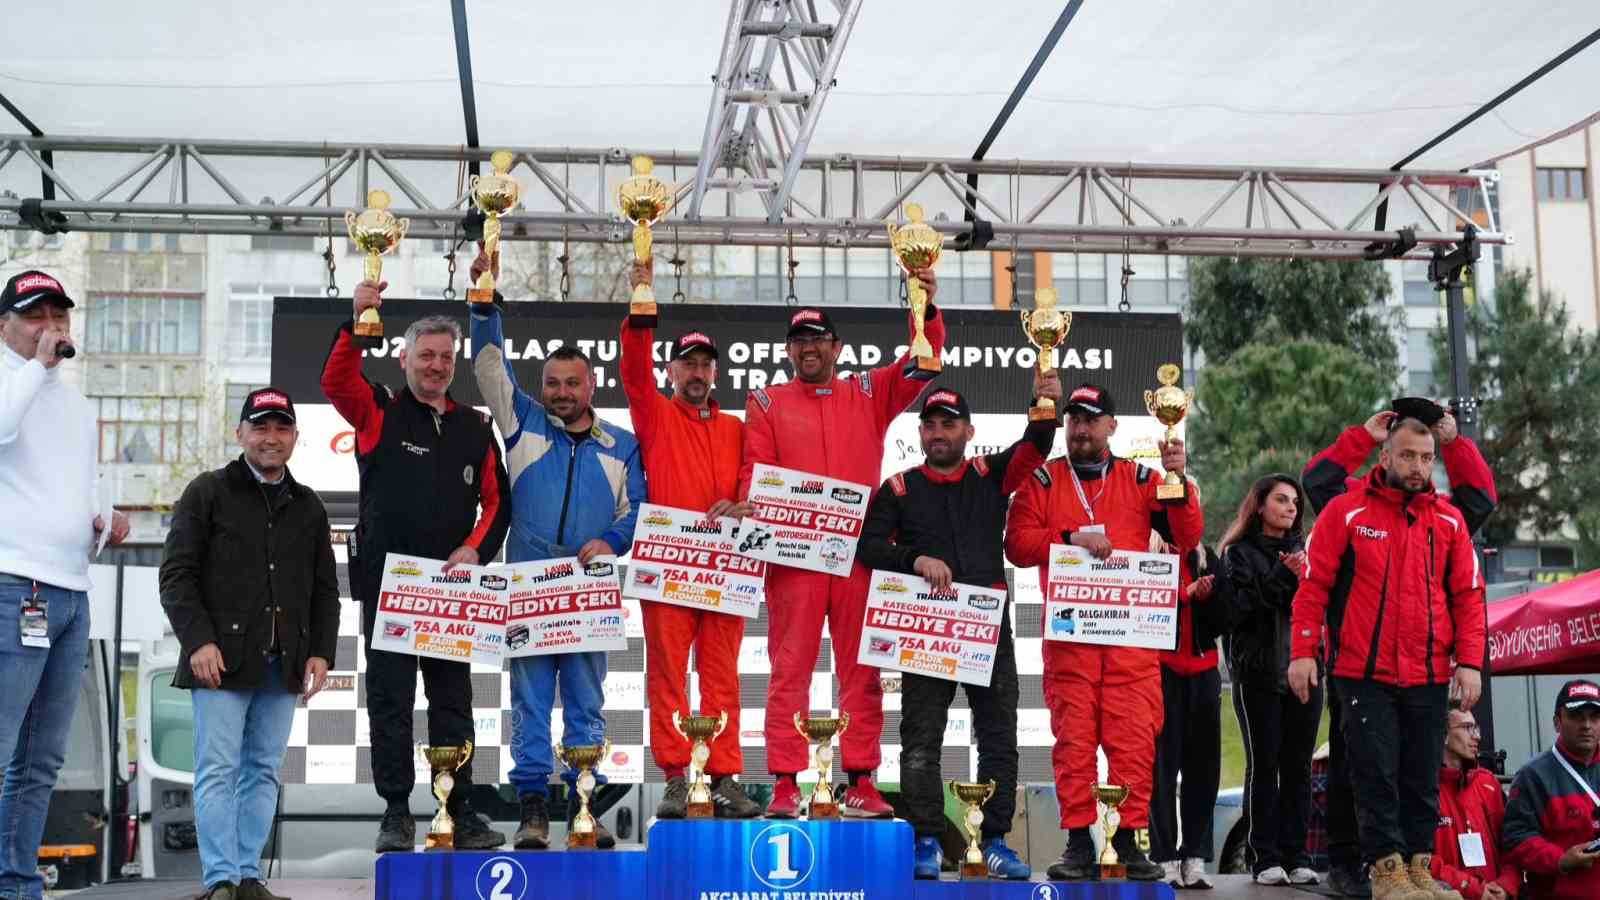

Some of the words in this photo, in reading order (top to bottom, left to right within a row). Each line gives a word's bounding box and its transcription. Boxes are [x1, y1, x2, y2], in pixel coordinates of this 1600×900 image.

[727, 342, 881, 365] OFFAD
[663, 569, 688, 582] 75A
[511, 595, 570, 616] EDİYE
[413, 621, 440, 634] 75A
[1488, 618, 1562, 660] BÜYÜKŞEHİR
[1567, 612, 1600, 646] BELE
[898, 636, 925, 650] 75A
[767, 832, 799, 879] 1
[490, 862, 513, 900] 2
